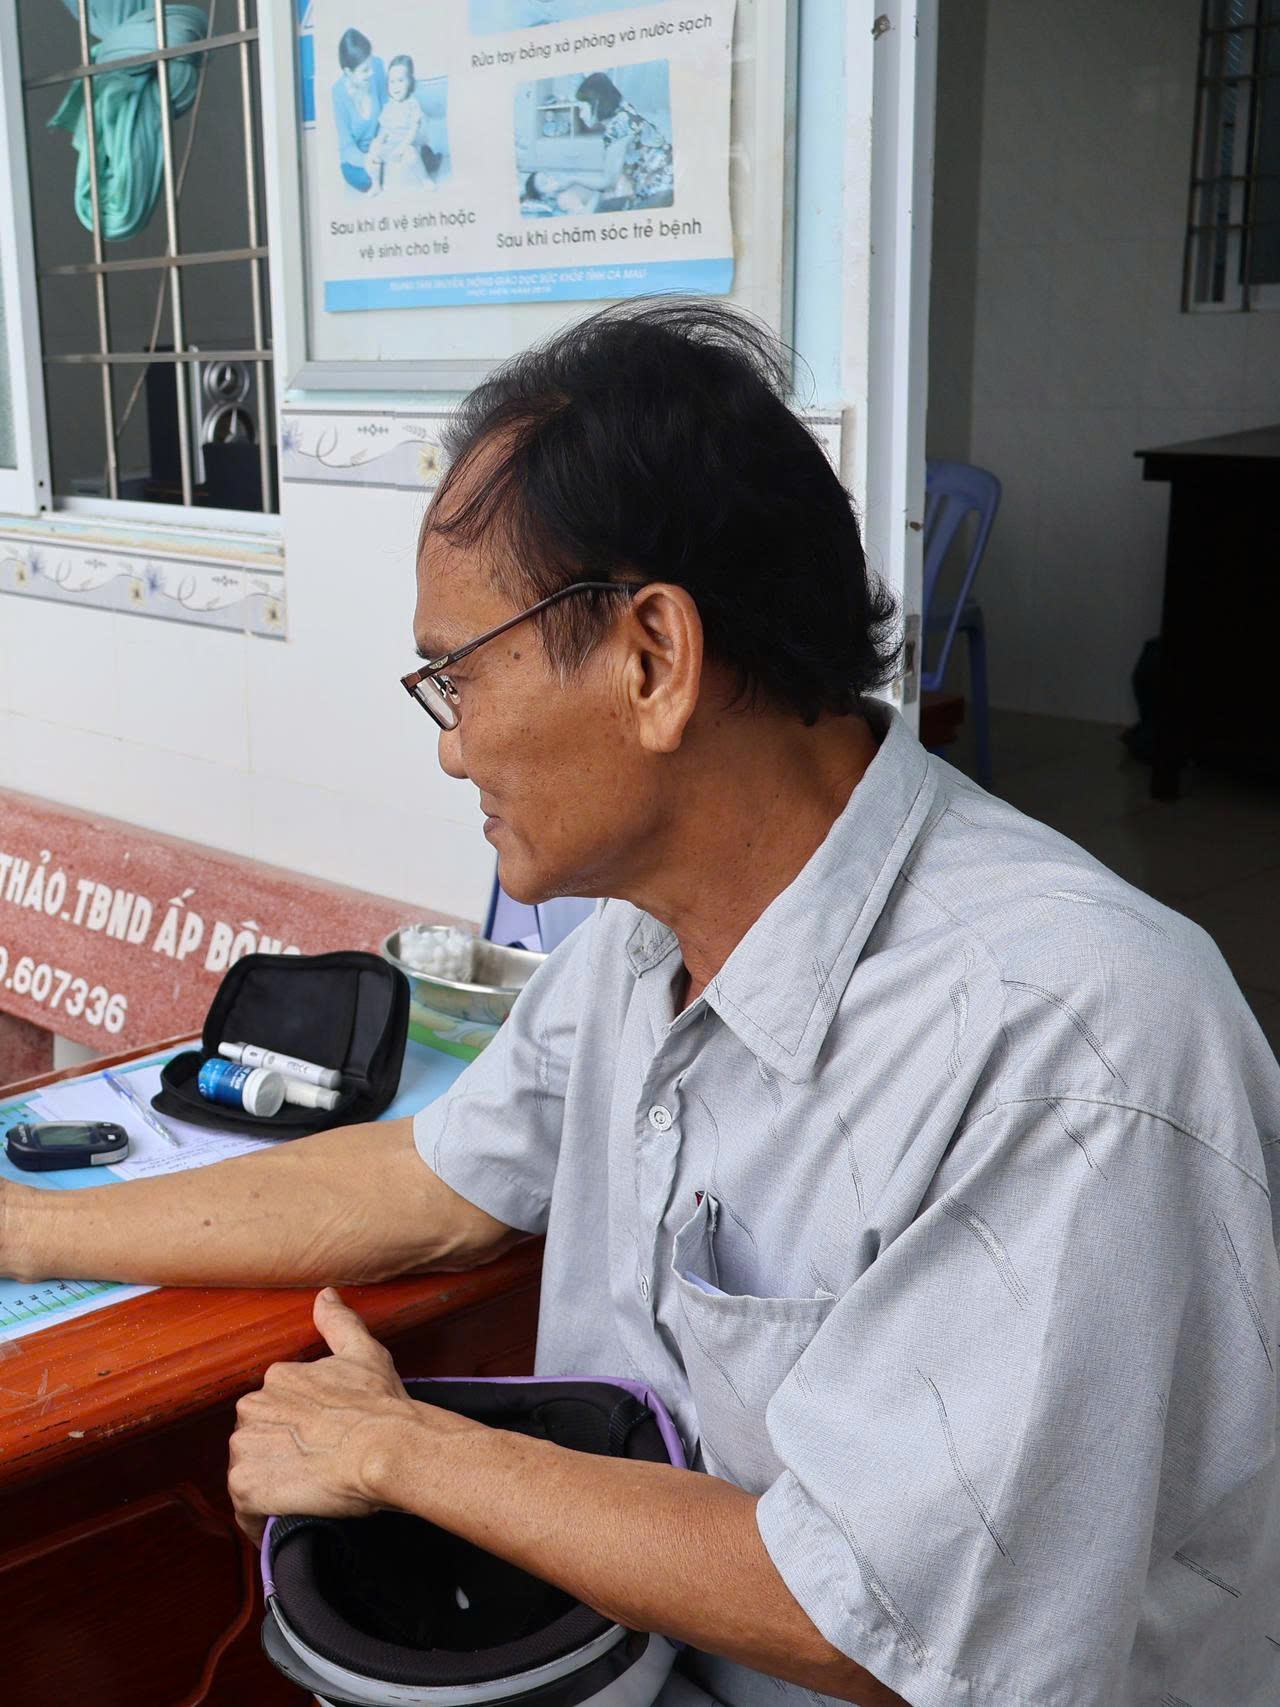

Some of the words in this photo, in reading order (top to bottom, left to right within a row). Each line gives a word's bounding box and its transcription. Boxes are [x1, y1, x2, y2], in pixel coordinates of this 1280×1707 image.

[497, 48, 516, 65] tay
[574, 31, 616, 52] phòng
[619, 25, 636, 42] và
[640, 20, 675, 39] nước
[678, 13, 713, 35] sạch
[330, 221, 355, 236] Sau
[357, 219, 376, 233] khi
[378, 216, 390, 231] đi
[393, 214, 409, 231] vệ
[413, 212, 437, 229] sinh
[440, 209, 476, 228] hoặc
[496, 232, 523, 249] Sau
[526, 229, 548, 247] khi
[552, 226, 596, 244] chăm
[600, 223, 629, 241] sóc
[633, 218, 654, 239] trẻ
[659, 217, 702, 240] bệnh
[359, 244, 376, 262] vệ
[379, 242, 402, 258] sinh
[406, 241, 431, 256] cho
[433, 236, 450, 254] trẻ
[152, 887, 205, 961] ẤP
